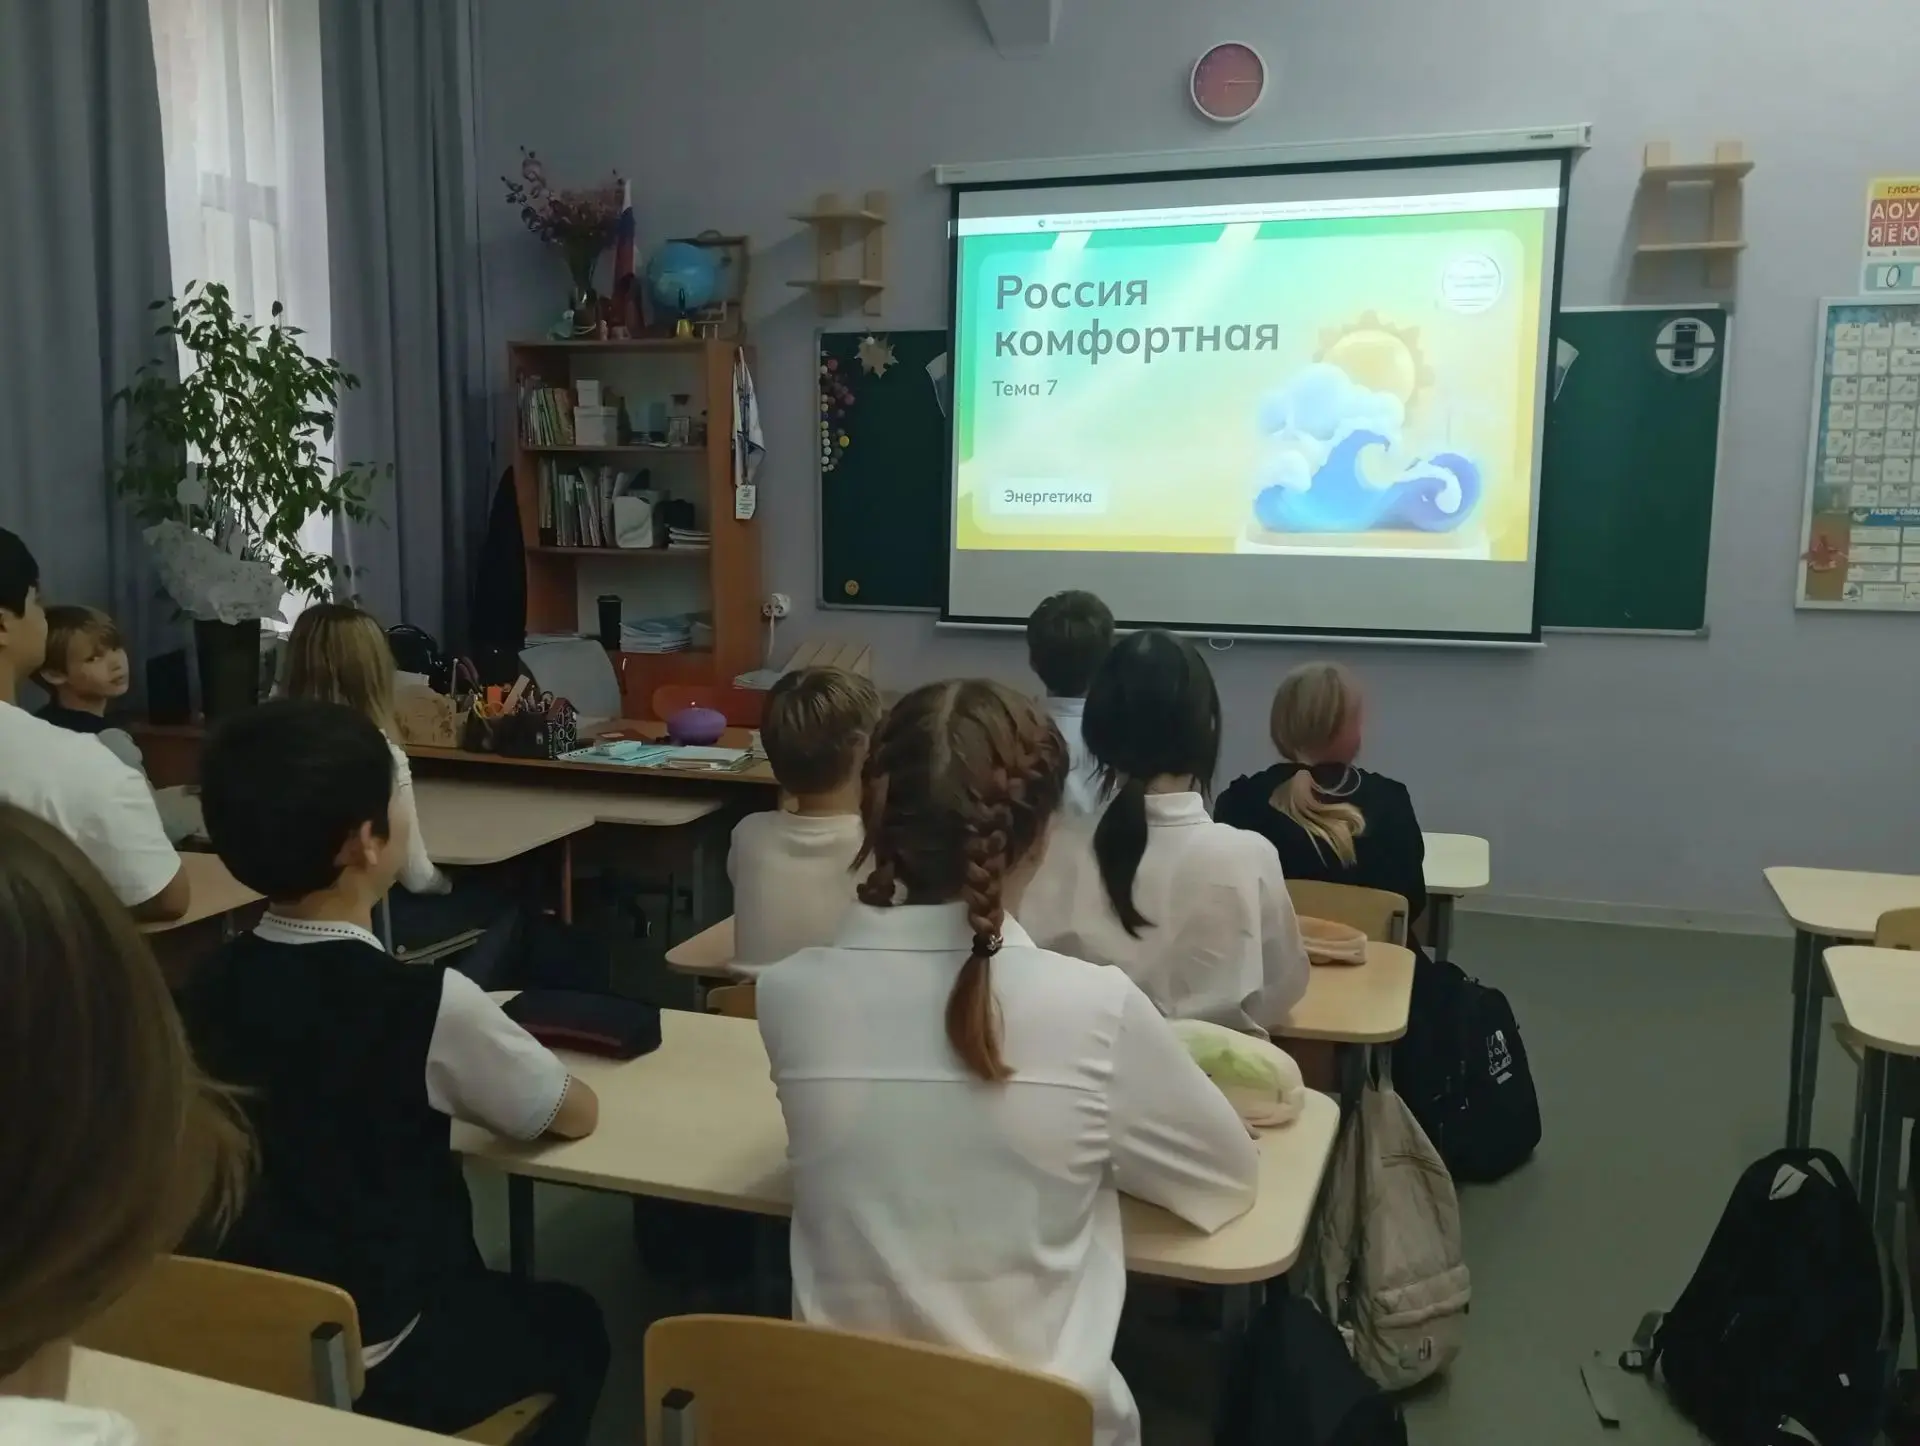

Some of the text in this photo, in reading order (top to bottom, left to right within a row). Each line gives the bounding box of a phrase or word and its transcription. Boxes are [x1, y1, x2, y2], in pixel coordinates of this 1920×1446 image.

[1871, 203, 1885, 220] А
[1888, 202, 1903, 220] О
[1870, 223, 1919, 243] Я Ё Ю
[996, 274, 1148, 310] Россия
[995, 317, 1279, 365] комфортная
[992, 379, 1058, 396] Тема 7
[1004, 489, 1092, 506] Энергетика
